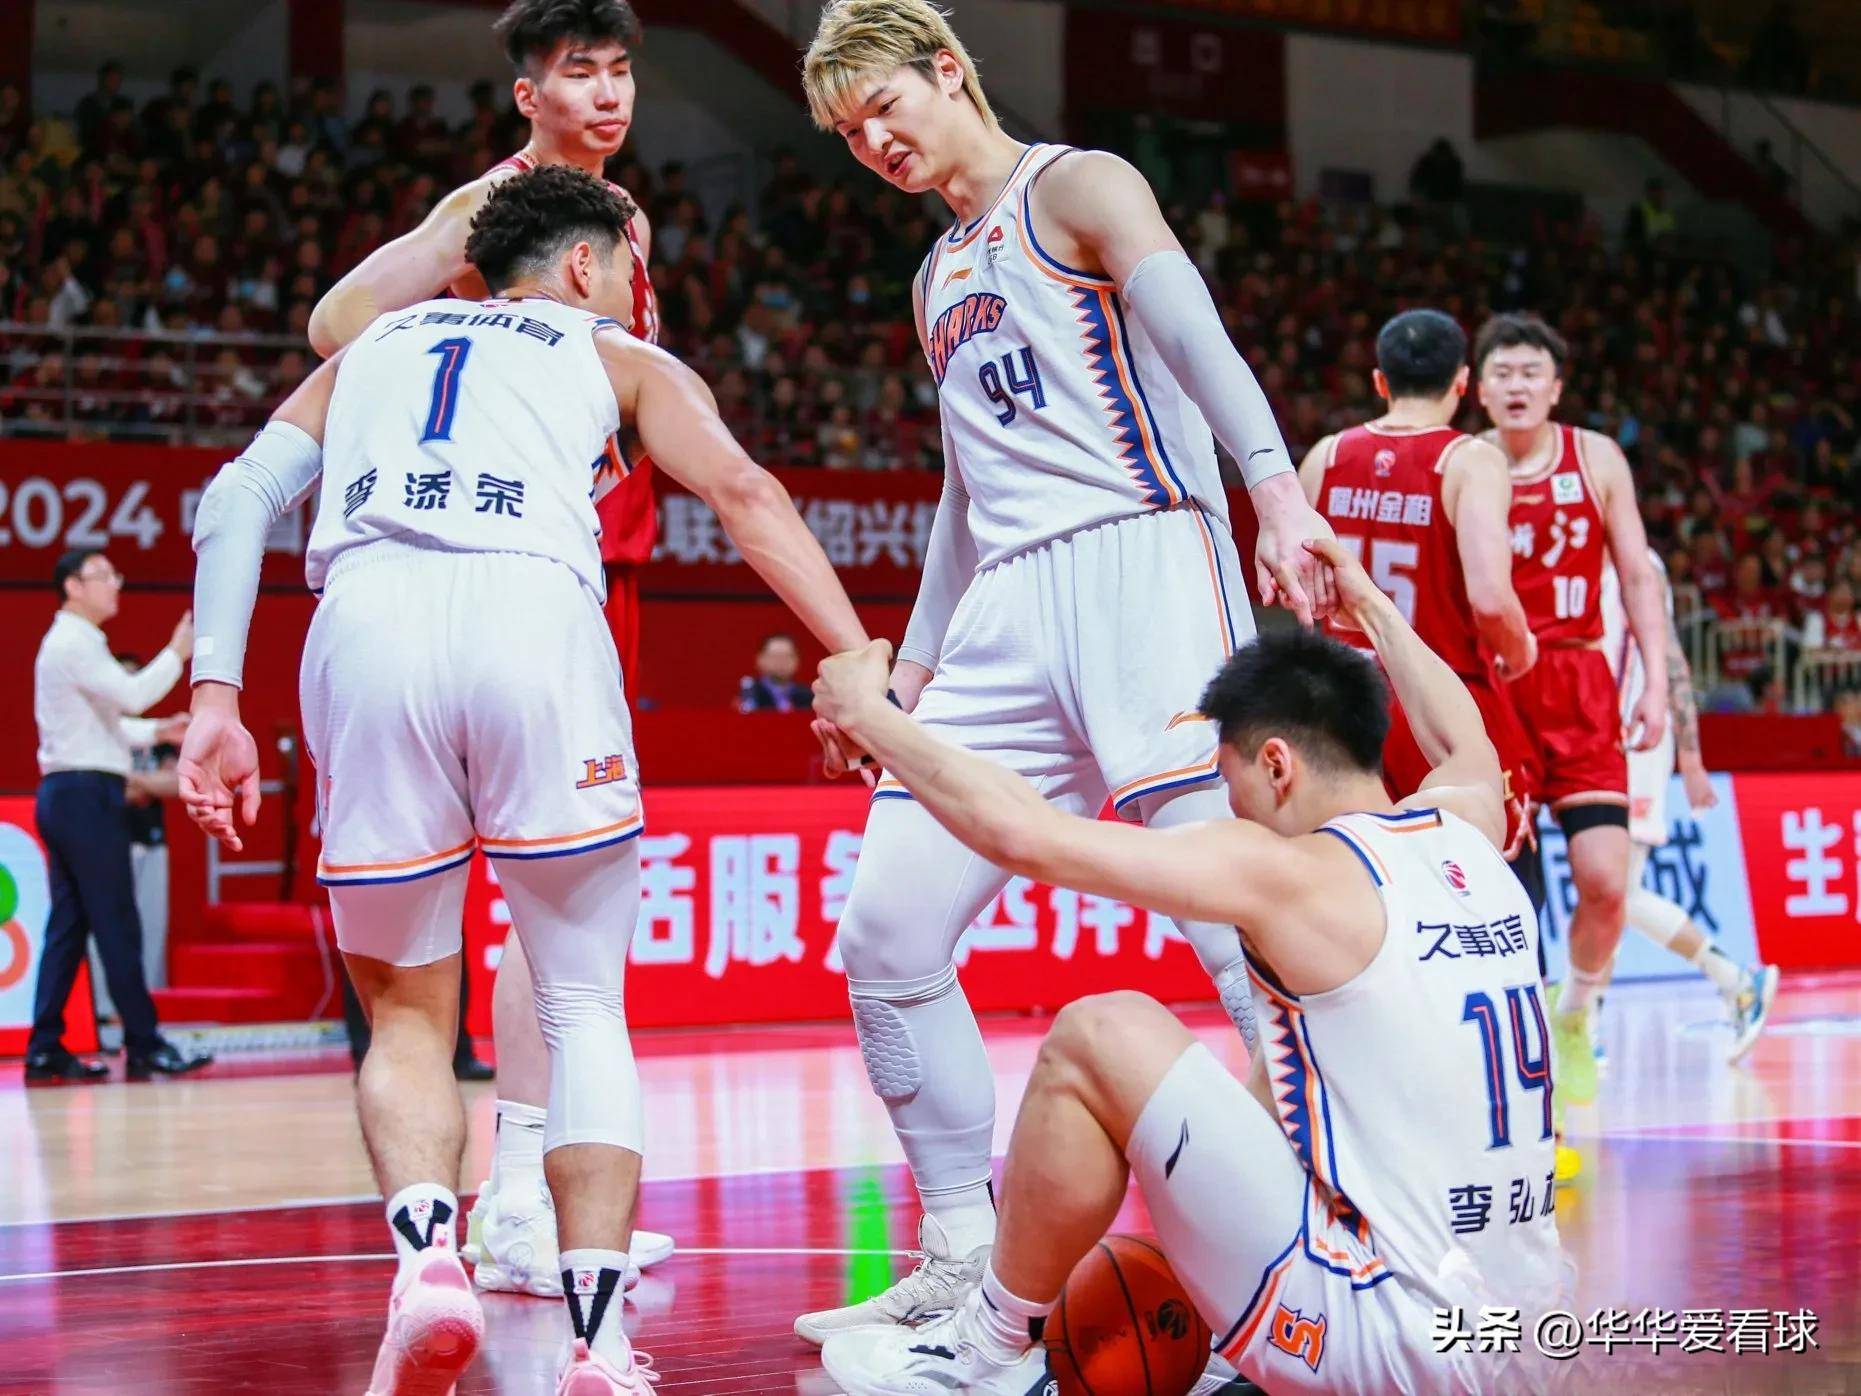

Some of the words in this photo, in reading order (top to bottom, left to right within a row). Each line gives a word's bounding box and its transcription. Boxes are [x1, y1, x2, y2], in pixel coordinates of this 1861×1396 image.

[375, 312, 565, 347] 久事体育
[930, 292, 1008, 388] HARKS
[425, 336, 475, 444] 1
[978, 345, 1048, 427] 94
[0, 475, 164, 550] 024
[1553, 575, 1587, 619] 10
[576, 754, 628, 789] 上海
[1460, 982, 1554, 1151] 14
